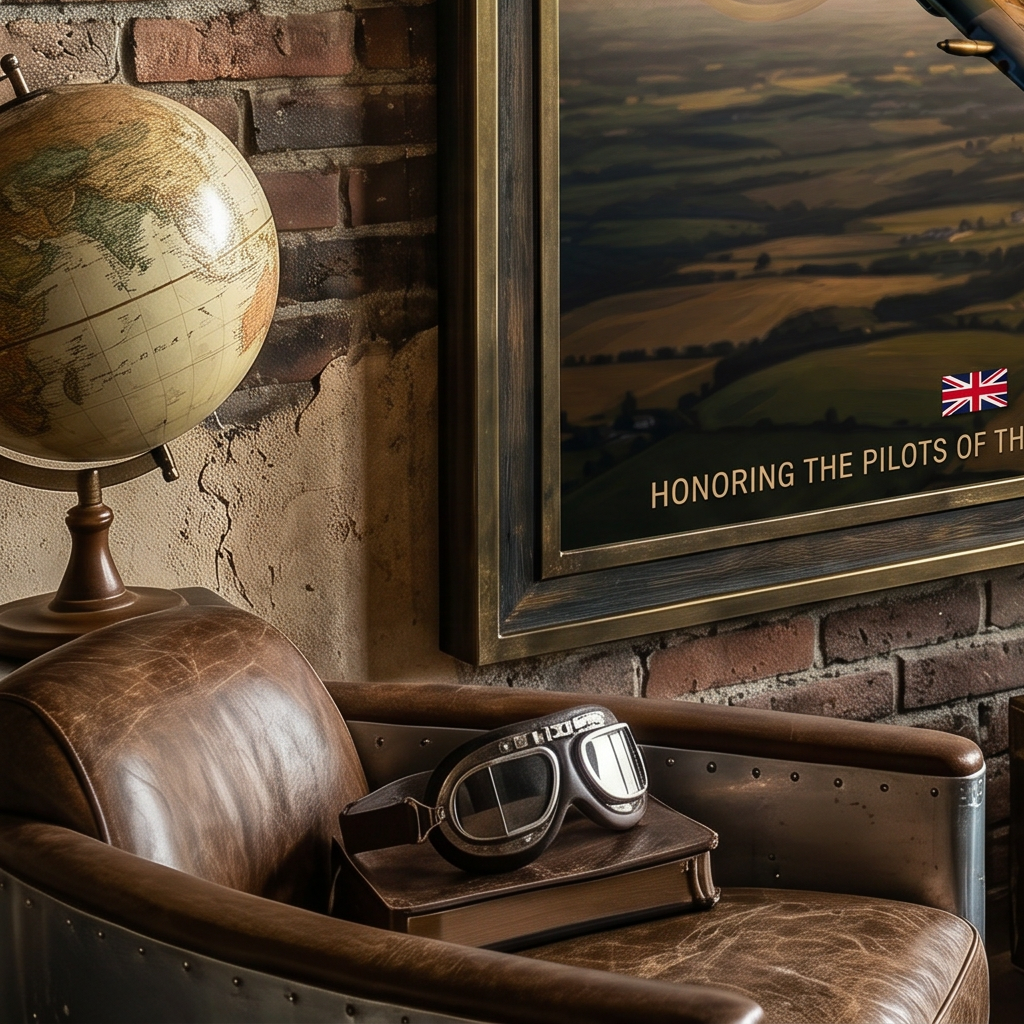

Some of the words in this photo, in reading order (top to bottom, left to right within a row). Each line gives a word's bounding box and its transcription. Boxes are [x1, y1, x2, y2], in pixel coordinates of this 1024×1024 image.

[650, 461, 795, 509] HONORING
[803, 451, 854, 484] THE
[862, 437, 948, 475] PILOTS
[956, 431, 987, 460] OF
